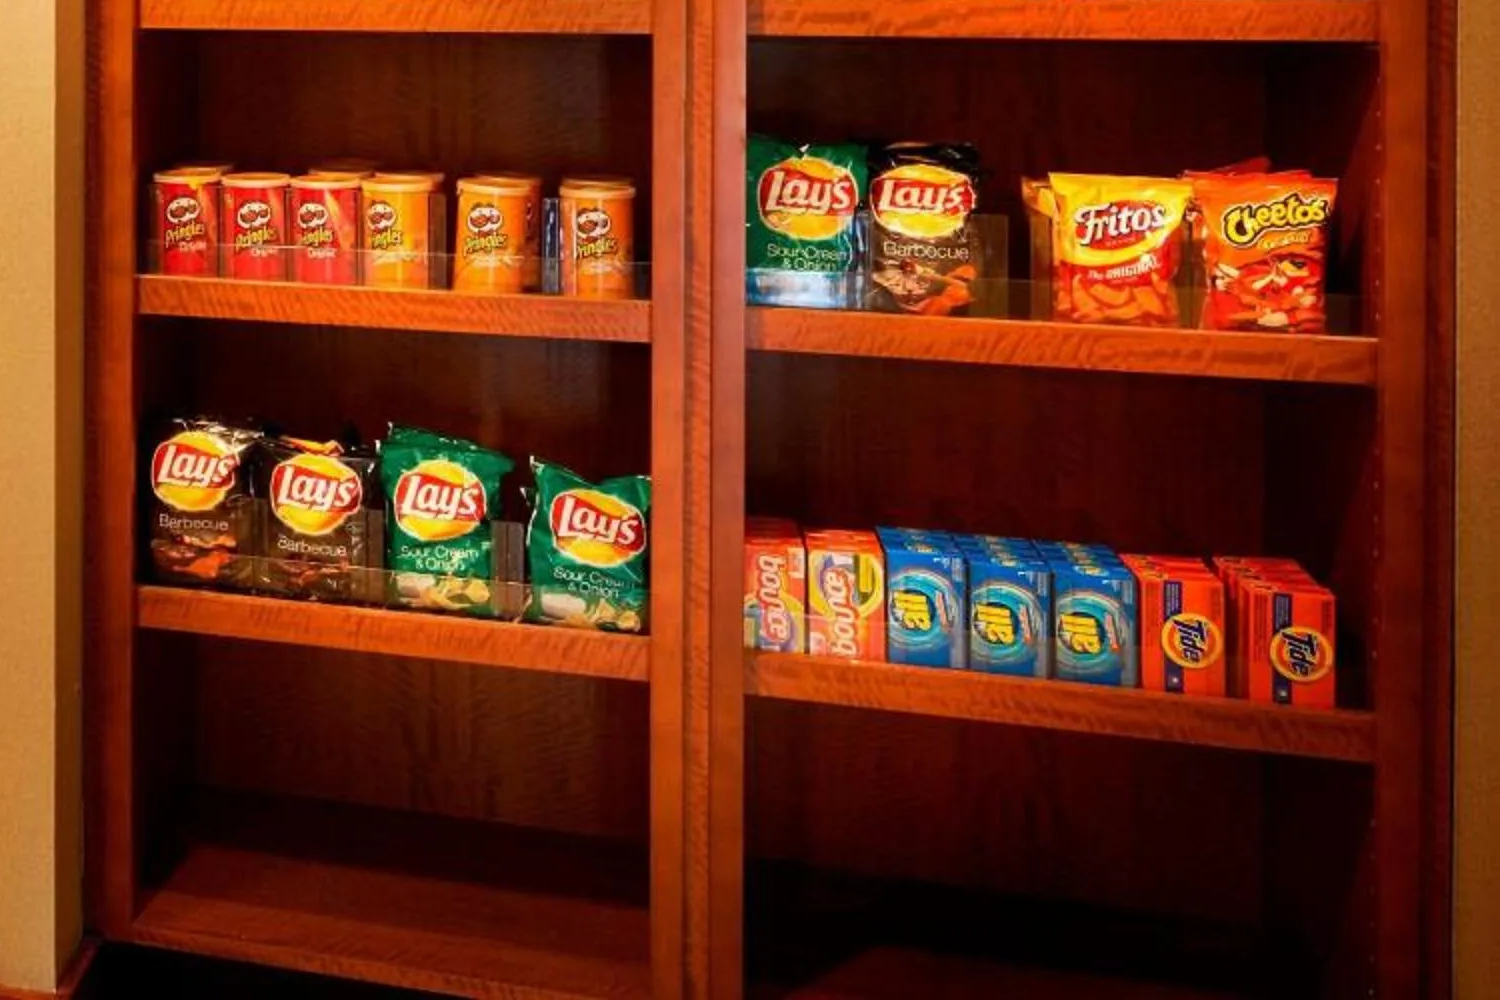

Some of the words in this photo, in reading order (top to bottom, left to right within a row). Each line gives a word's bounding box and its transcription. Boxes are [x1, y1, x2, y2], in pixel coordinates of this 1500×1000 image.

[765, 170, 851, 215] Lay's
[877, 179, 967, 217] Lay's
[165, 222, 206, 249] Pringles
[1074, 201, 1170, 246] Fritos
[1222, 193, 1329, 247] Cheetos
[767, 243, 798, 259] Sour
[795, 257, 837, 272] Onion
[883, 240, 970, 260] Barbecue
[156, 444, 238, 488] Lay's
[276, 464, 360, 512] Lay's
[400, 474, 480, 520] Lay's
[159, 513, 230, 531] Barbecue
[557, 496, 640, 545] Lay's
[276, 535, 348, 558] Barbecue
[400, 544, 433, 558] Sour
[553, 567, 586, 582] Sour
[578, 582, 620, 599] Onion
[758, 554, 791, 641] bounce
[825, 567, 857, 657] bounce
[891, 589, 932, 632] all
[975, 602, 1016, 645] all
[1059, 614, 1102, 655] all
[1173, 619, 1210, 664] Tide
[1281, 631, 1321, 676] Tide
